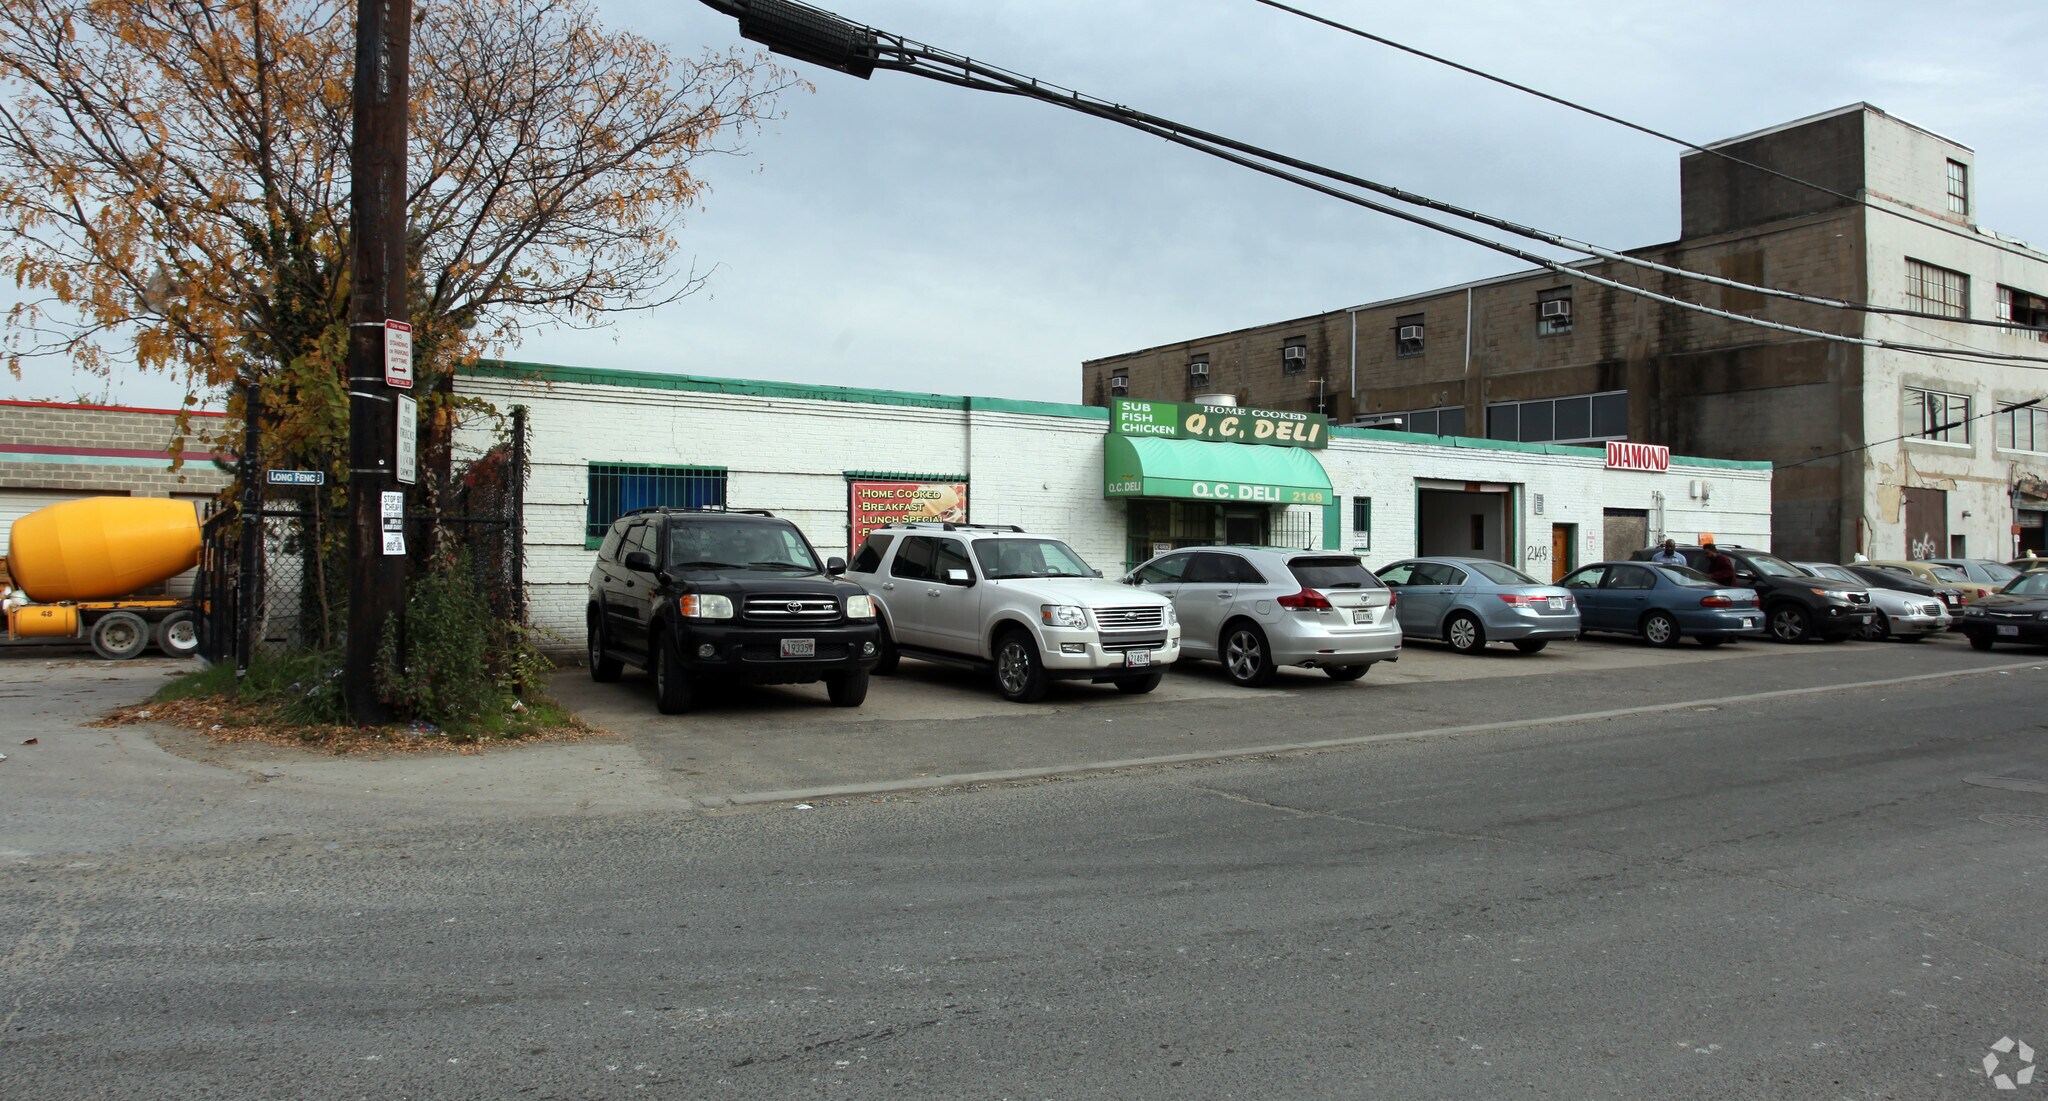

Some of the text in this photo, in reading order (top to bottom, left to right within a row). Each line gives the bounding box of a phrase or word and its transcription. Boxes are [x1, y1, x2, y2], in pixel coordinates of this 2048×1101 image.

[389, 340, 409, 349] STANDING
[394, 349, 409, 357] PARKING
[391, 357, 408, 365] ANYTIME
[1121, 401, 1152, 412] SUB
[1121, 412, 1153, 423] FISH
[1203, 405, 1308, 421] HOME COOKED
[1121, 422, 1175, 435] CHICKEN
[1254, 419, 1320, 443] DELI
[1607, 442, 1669, 471] DIAMOND
[271, 472, 293, 482] LONG
[1124, 481, 1141, 492] DELI
[383, 495, 396, 503] STOP
[862, 489, 942, 499] HOME COOKED
[1238, 485, 1281, 502] DELI
[1292, 491, 1323, 503] 2149
[862, 502, 925, 512] BREAKFAST
[862, 515, 899, 524] LUNCH
[1527, 545, 1548, 561] 2149
